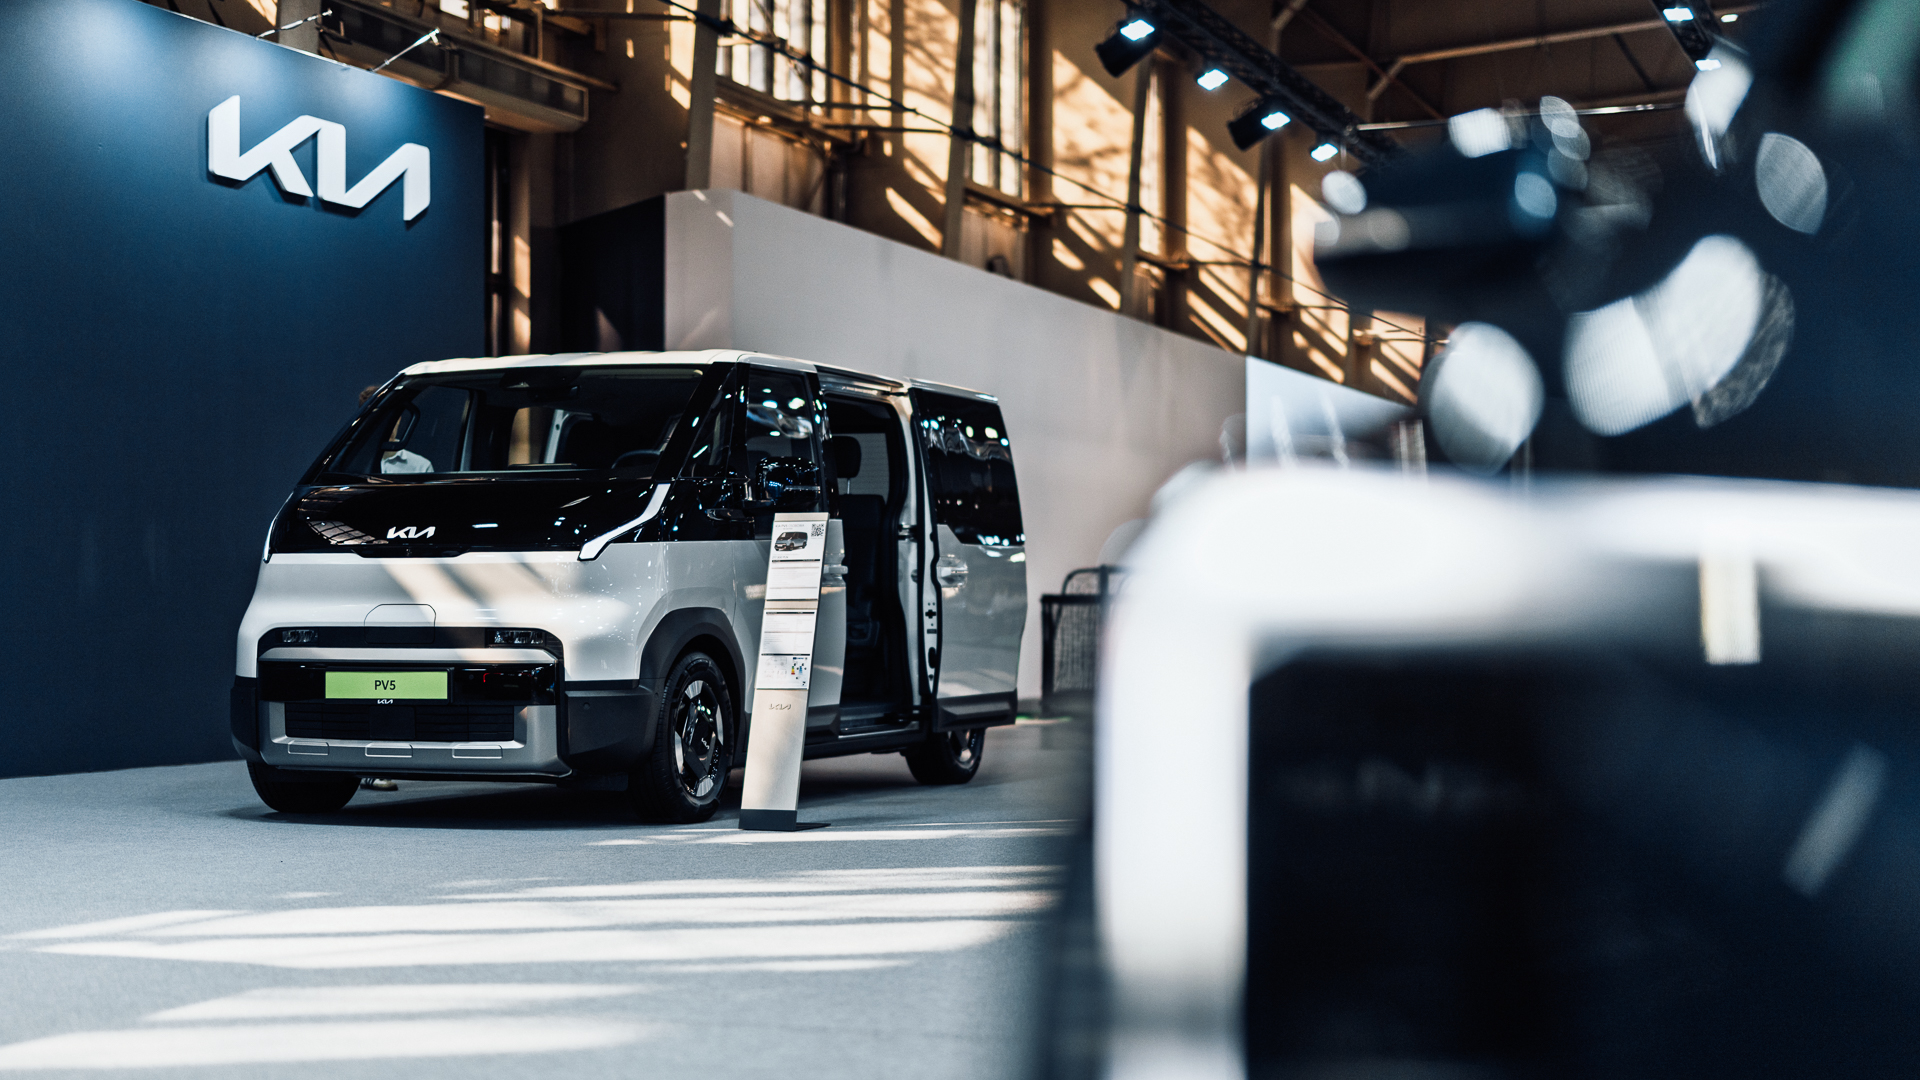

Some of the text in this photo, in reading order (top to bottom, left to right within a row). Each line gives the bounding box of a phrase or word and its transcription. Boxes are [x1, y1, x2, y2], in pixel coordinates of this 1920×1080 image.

[208, 94, 431, 221] KIA
[386, 526, 436, 539] KIA
[374, 679, 396, 691] PV5
